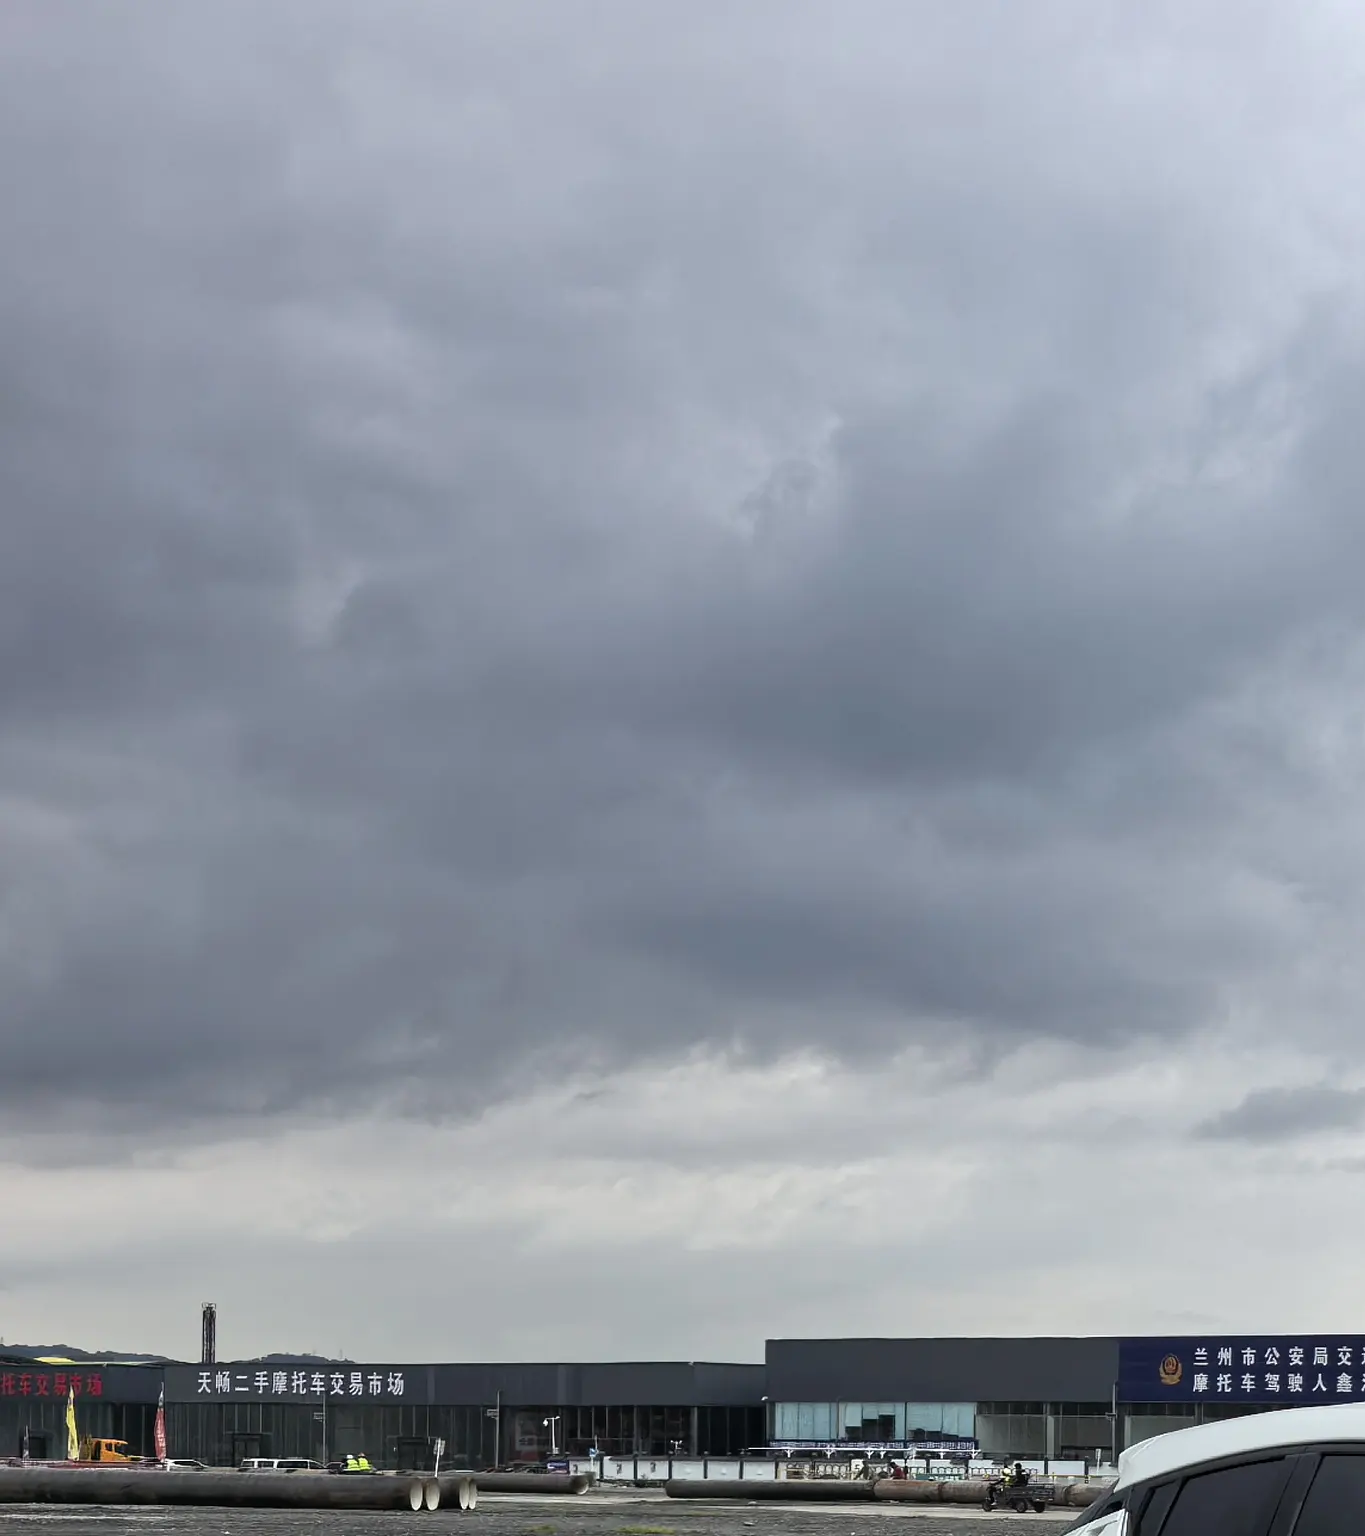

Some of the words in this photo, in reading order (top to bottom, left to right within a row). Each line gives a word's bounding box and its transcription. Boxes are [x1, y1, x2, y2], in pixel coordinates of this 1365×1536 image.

[197, 1370, 405, 1396] 天畅二手摩托车交易市场
